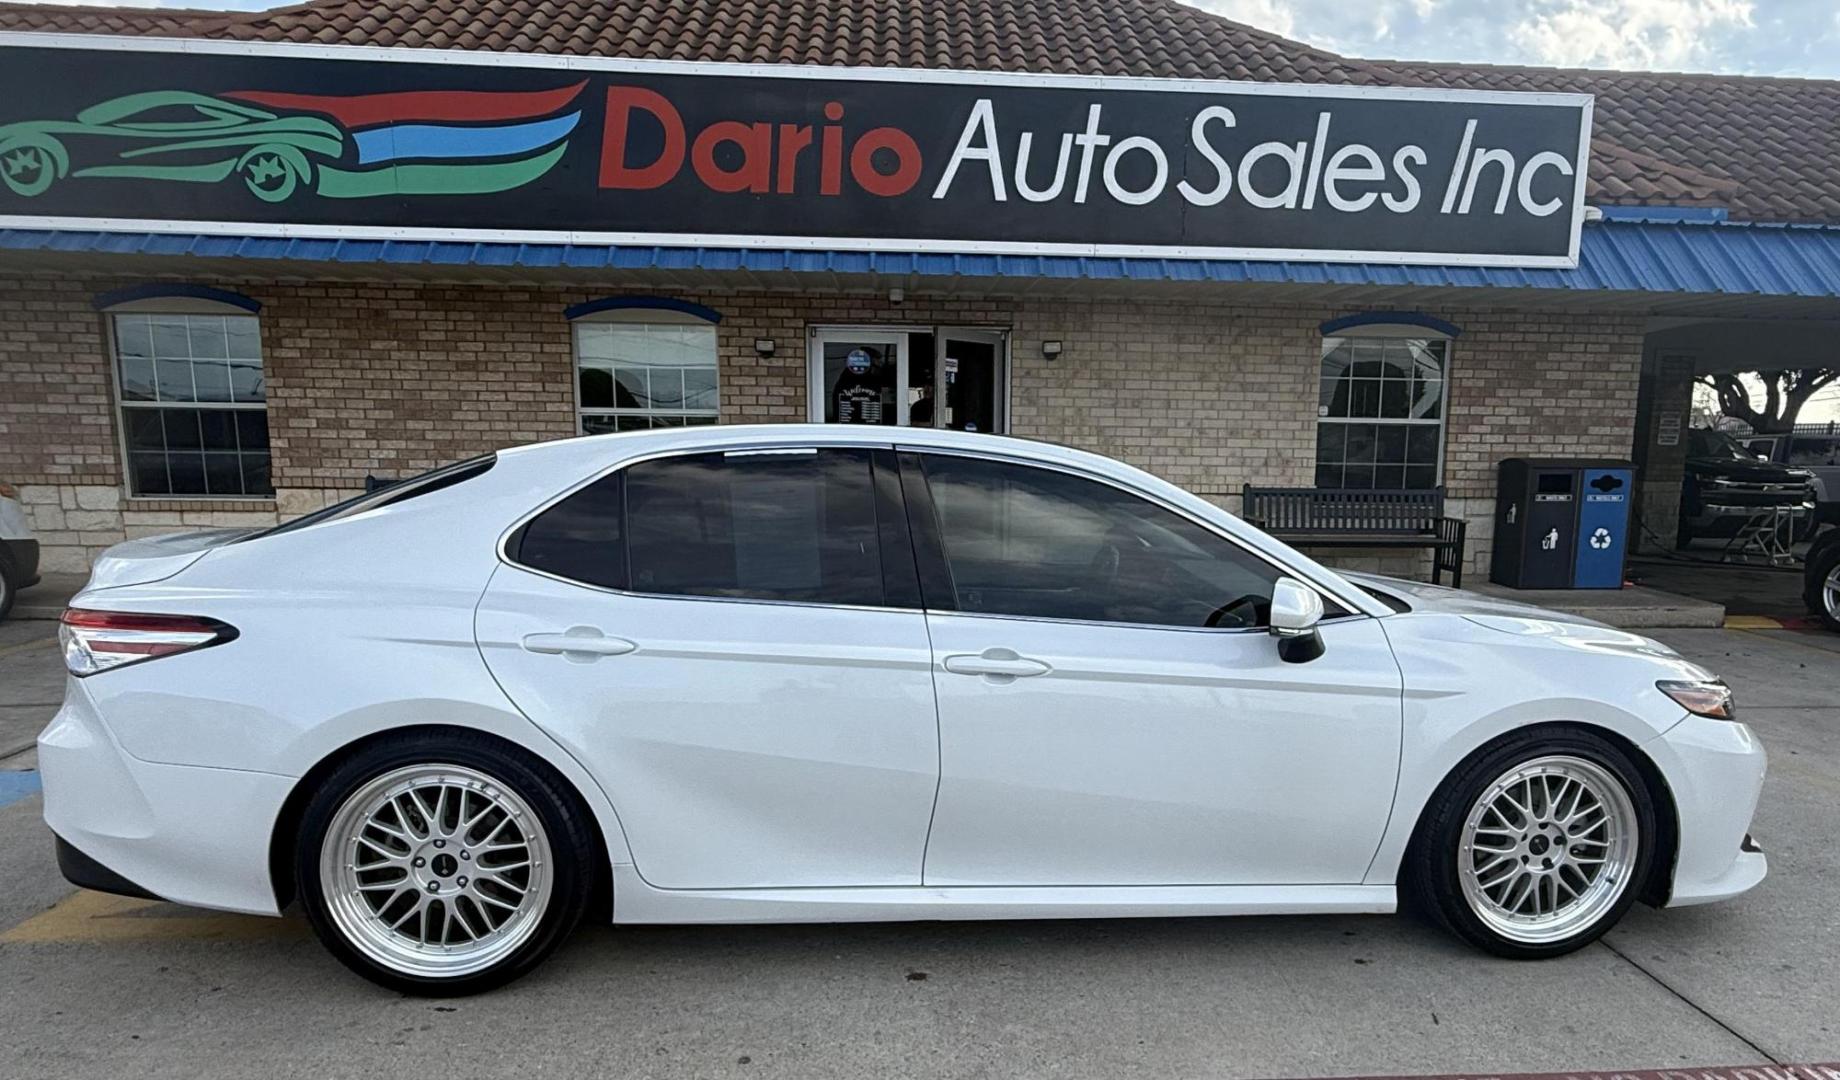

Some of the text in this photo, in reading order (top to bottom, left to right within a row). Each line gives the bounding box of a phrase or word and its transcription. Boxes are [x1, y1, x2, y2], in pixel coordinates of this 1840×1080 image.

[599, 85, 1574, 217] Dario Auto Sales Inc
